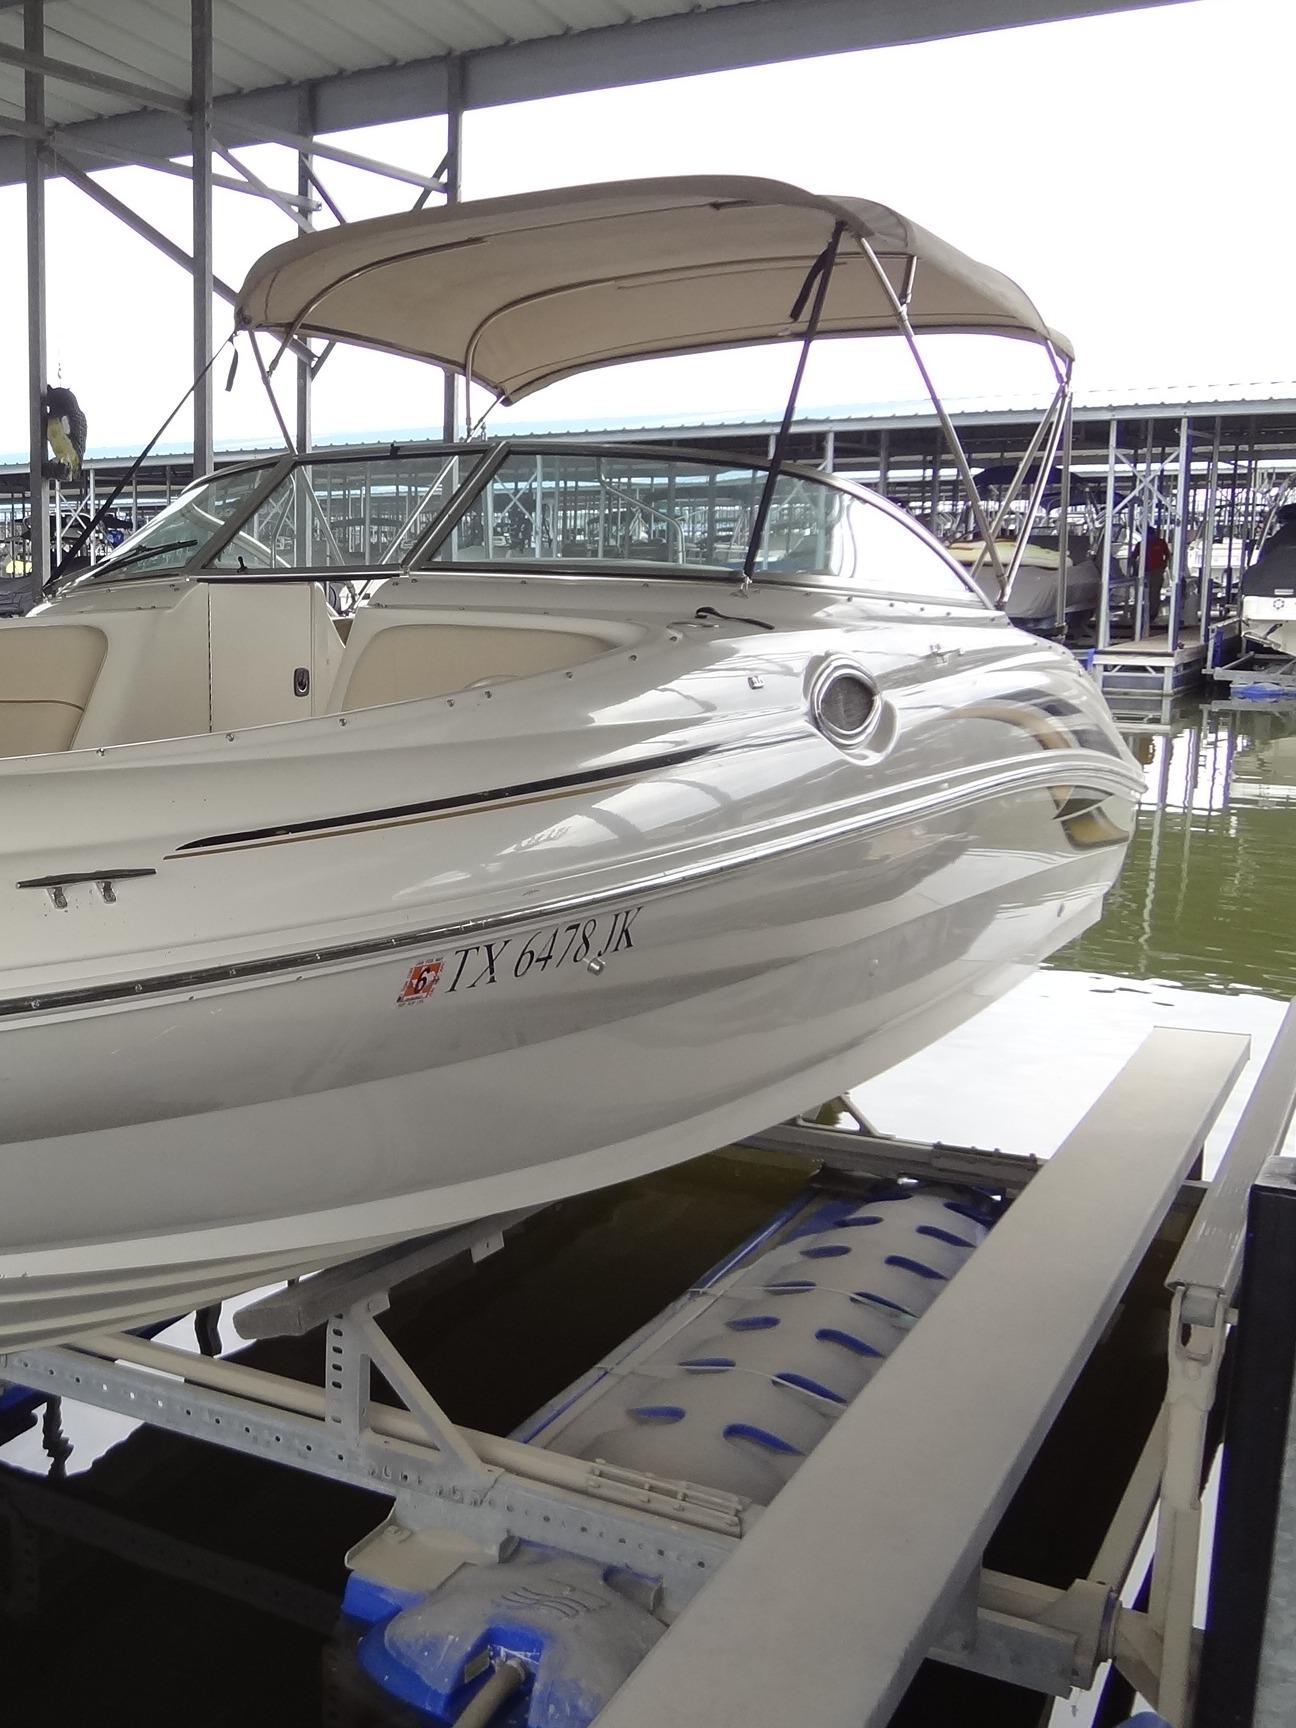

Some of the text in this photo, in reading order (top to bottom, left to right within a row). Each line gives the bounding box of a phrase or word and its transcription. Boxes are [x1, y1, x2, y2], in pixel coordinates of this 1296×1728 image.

[444, 906, 644, 993] TX 6478 JK
[414, 967, 431, 994] 6
